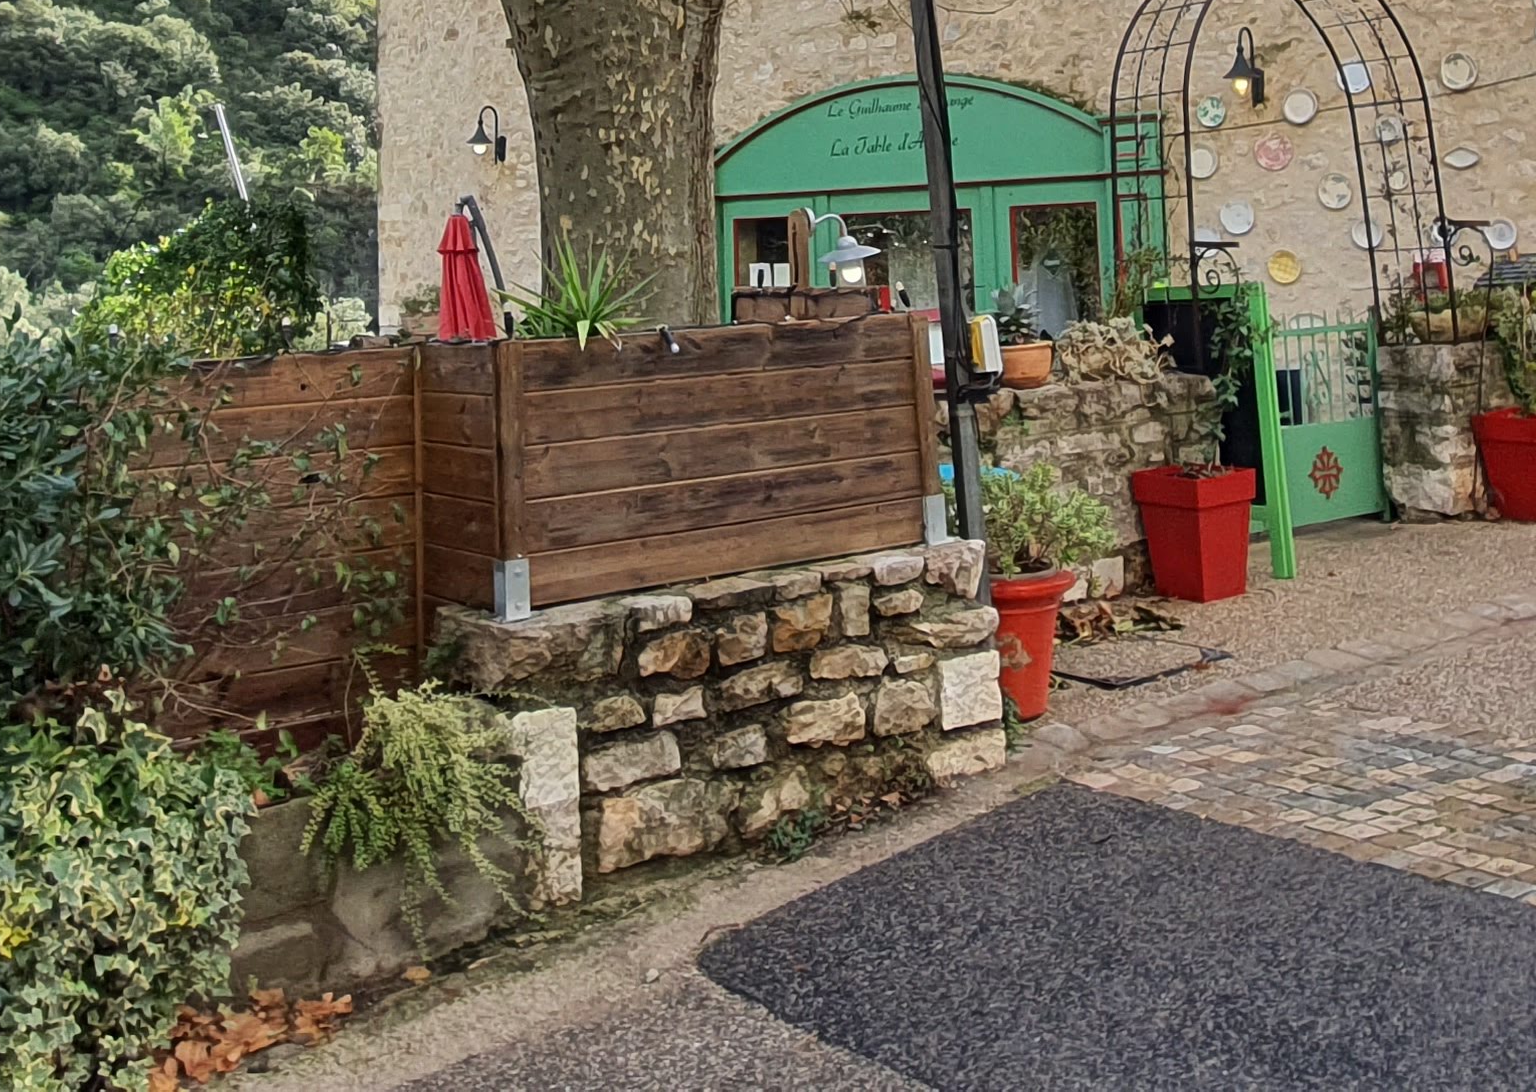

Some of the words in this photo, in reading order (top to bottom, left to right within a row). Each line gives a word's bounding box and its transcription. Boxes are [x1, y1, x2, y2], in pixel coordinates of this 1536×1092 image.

[827, 101, 844, 117] Le
[830, 139, 849, 156] La
[854, 135, 892, 155] Table
